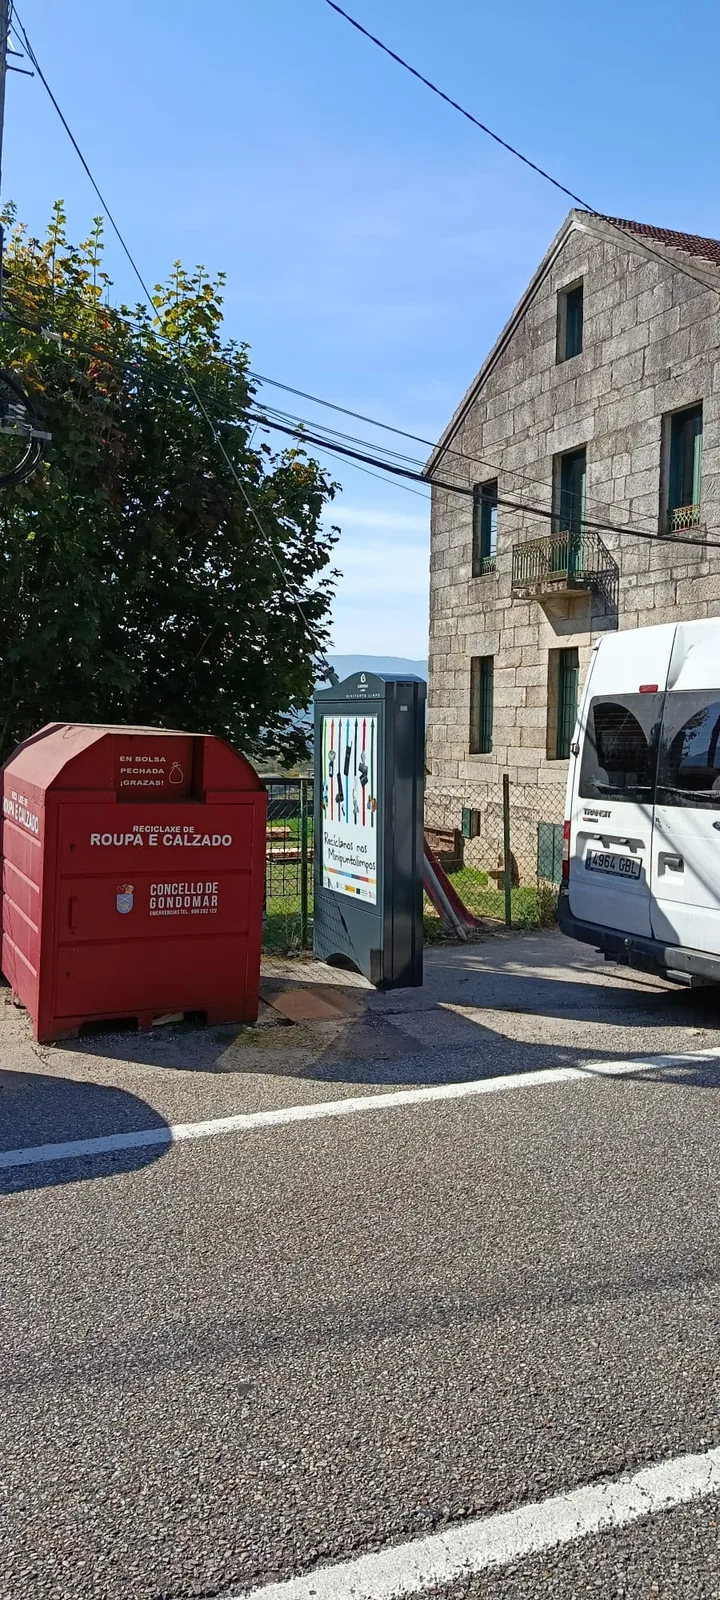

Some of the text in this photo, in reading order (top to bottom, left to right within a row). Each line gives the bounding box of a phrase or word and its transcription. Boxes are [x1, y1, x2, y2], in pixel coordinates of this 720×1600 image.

[120, 779, 164, 787] ¡GRAZAS!
[583, 808, 612, 818] TRANSIT
[132, 825, 181, 833] RECICLAXE
[90, 833, 232, 847] ROUPA E CALZADO
[356, 844, 368, 854] nos
[592, 852, 616, 870] 4964
[618, 857, 637, 875] GBL
[150, 881, 219, 896] CONCELLO DE
[149, 895, 218, 909] GONDOMAR
